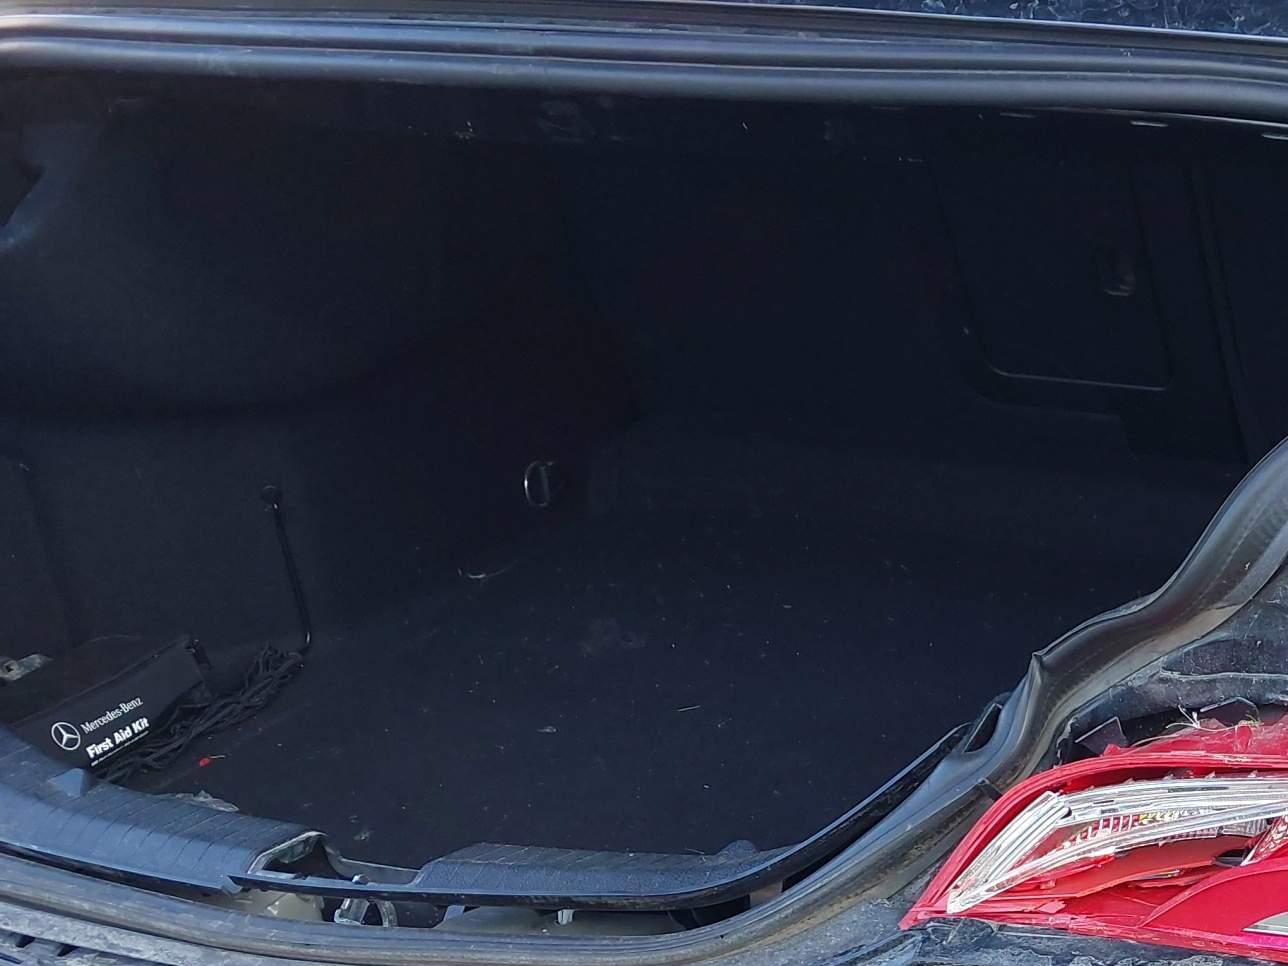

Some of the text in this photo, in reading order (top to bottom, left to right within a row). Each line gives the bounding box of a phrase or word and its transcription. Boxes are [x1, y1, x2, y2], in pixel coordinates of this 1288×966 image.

[80, 697, 144, 734] Mercedes-Benz
[86, 717, 150, 759] First Aid Kit
